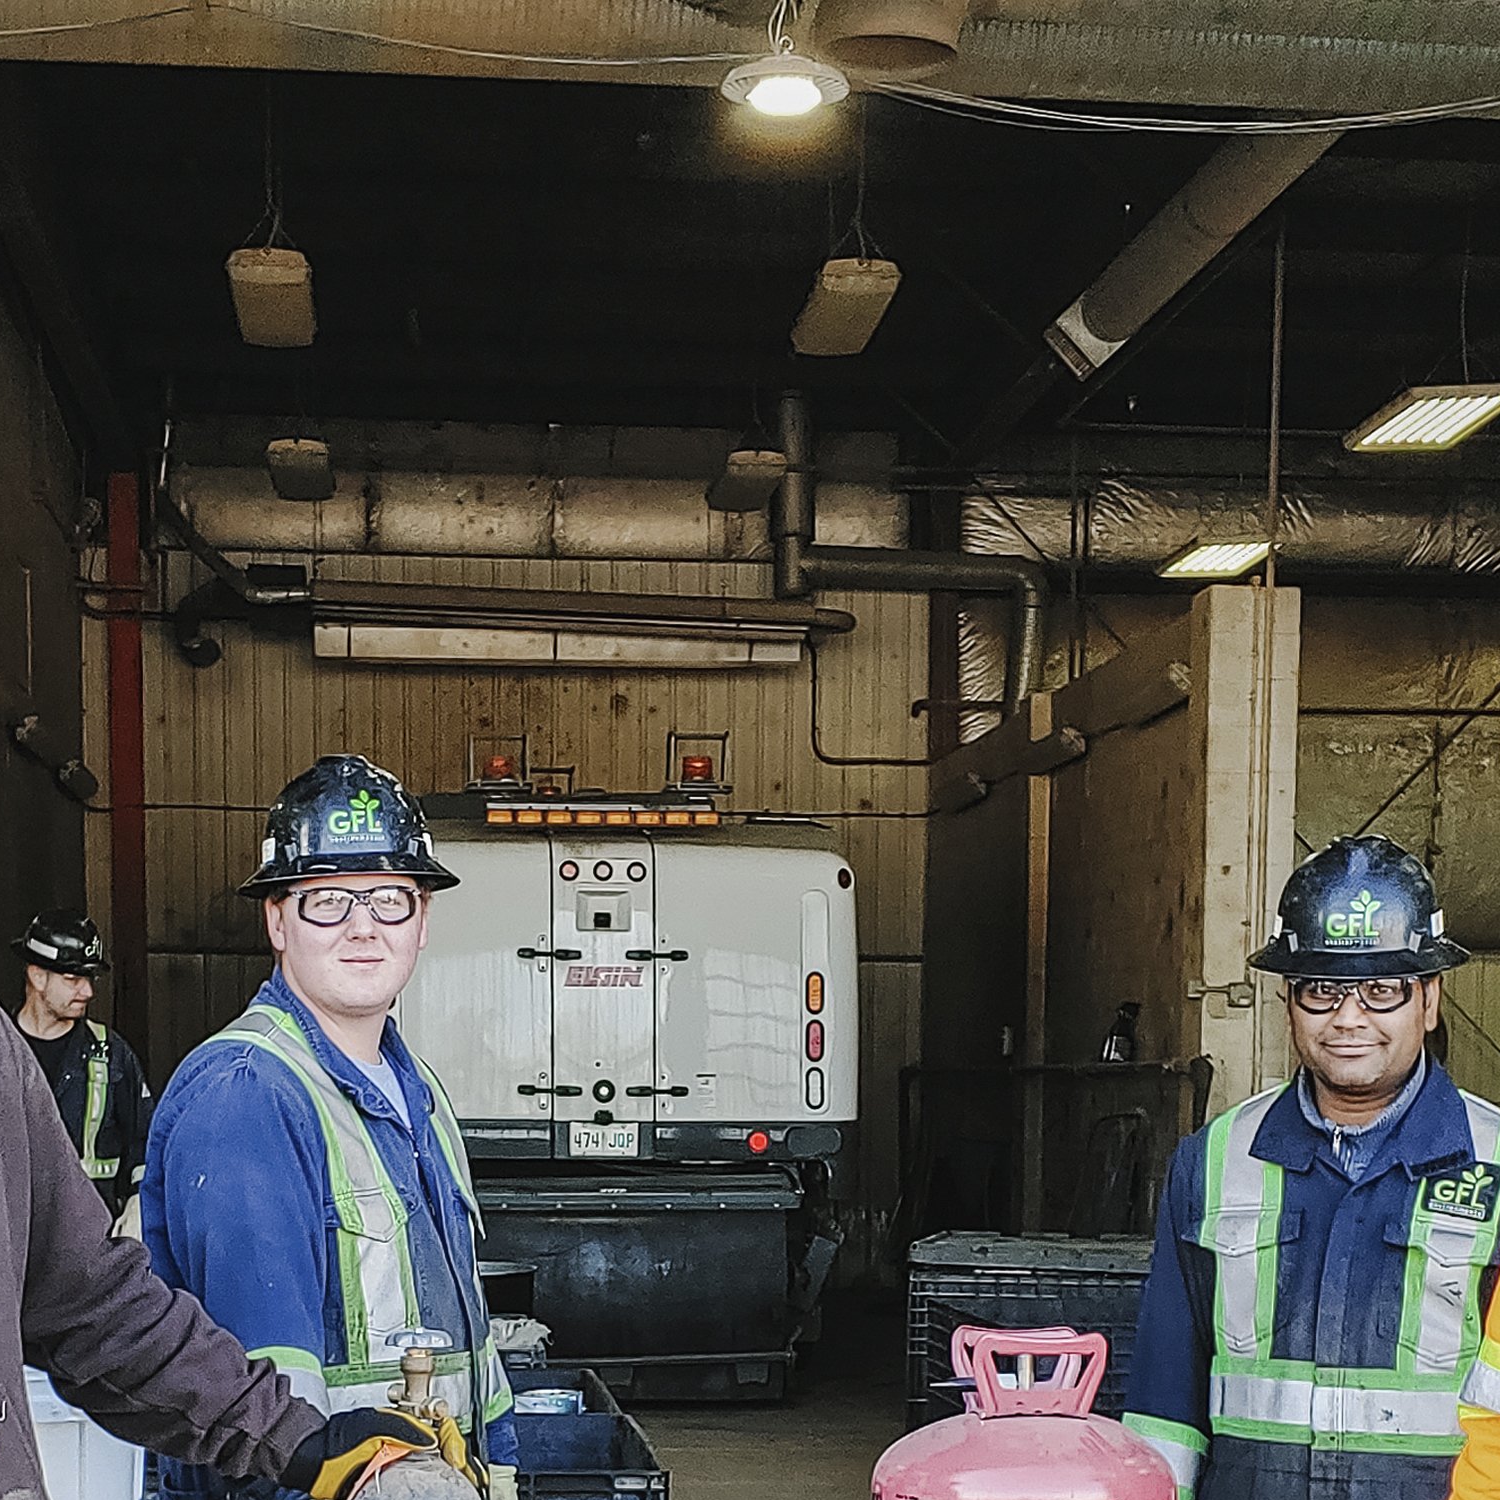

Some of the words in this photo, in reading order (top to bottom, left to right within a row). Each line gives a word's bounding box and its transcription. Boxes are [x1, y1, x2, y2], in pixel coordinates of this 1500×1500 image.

[328, 799, 384, 835] GFL
[1325, 901, 1380, 938] GFL
[564, 966, 646, 988] ELGIN
[573, 1131, 601, 1149] 474
[1433, 1173, 1488, 1210] GFL
